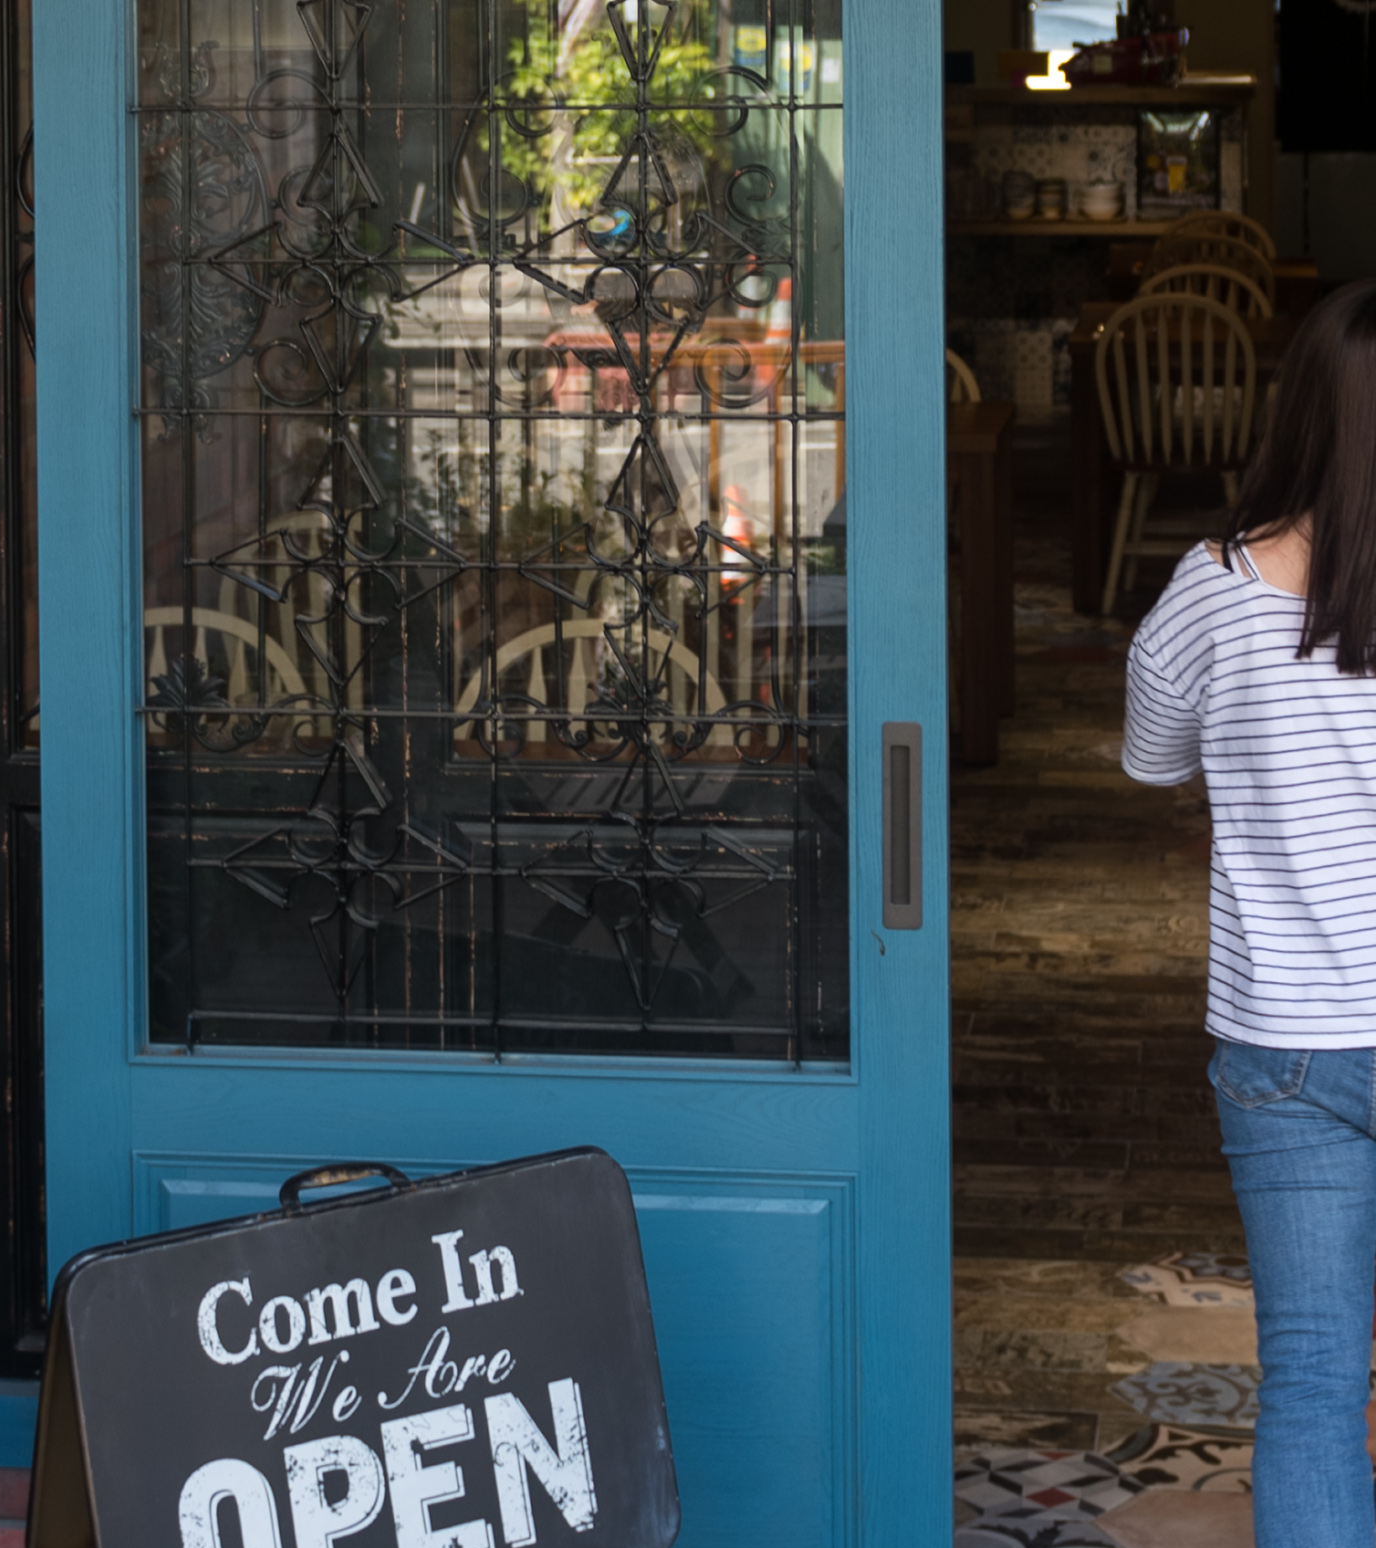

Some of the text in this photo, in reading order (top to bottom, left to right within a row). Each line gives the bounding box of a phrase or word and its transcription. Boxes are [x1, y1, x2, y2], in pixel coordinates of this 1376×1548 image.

[196, 1229, 525, 1365] Come In
[250, 1326, 516, 1441] We Are
